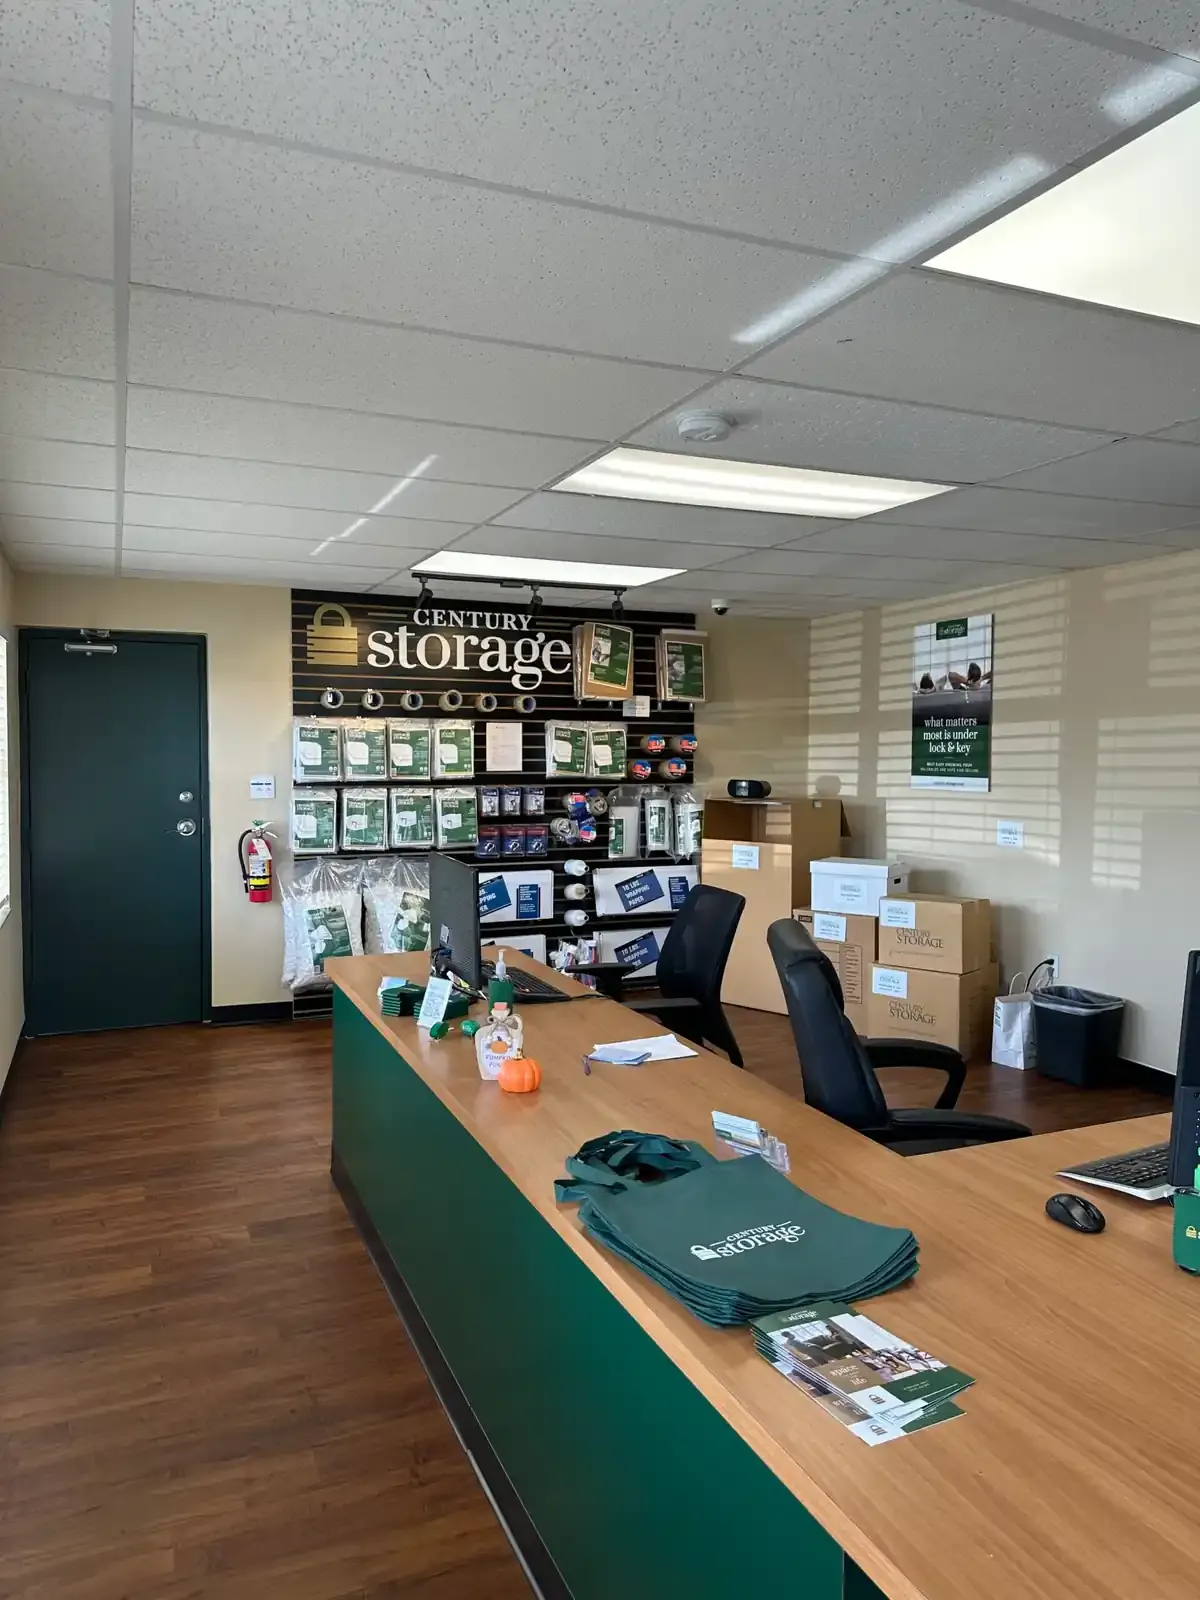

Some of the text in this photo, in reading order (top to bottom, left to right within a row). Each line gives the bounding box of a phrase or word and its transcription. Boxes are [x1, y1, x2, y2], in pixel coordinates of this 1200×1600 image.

[413, 608, 532, 631] CENTURY
[367, 625, 572, 691] storage
[924, 716, 977, 728] what matters
[923, 728, 979, 740] most is under
[929, 741, 971, 756] lock & key
[624, 884, 650, 899] WRAPPING
[628, 896, 645, 906] PAPER
[896, 928, 931, 938] CENTURY
[897, 935, 944, 949] STORAGE
[623, 947, 649, 963] WRAPPING
[889, 1000, 925, 1013] CENTURY
[889, 1008, 937, 1025] STORAGE
[726, 1224, 777, 1242] CENTURY
[716, 1225, 806, 1257] storage
